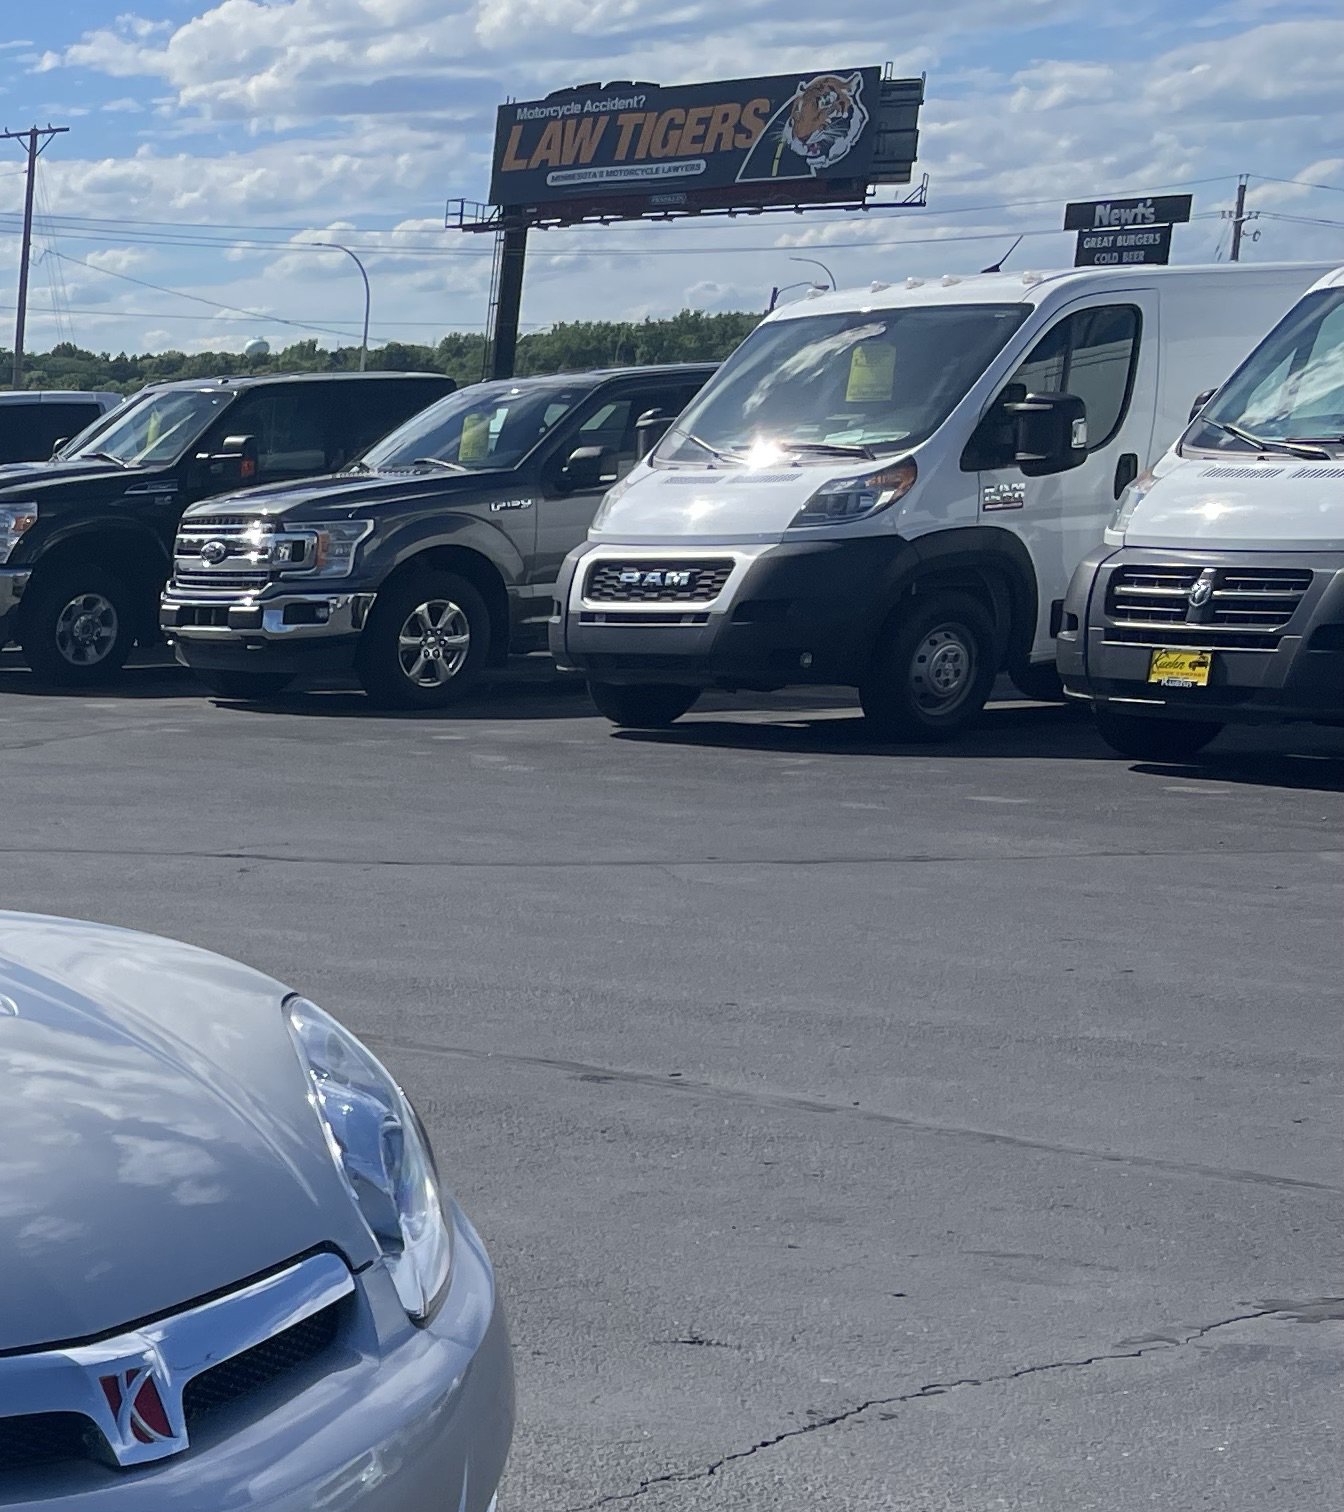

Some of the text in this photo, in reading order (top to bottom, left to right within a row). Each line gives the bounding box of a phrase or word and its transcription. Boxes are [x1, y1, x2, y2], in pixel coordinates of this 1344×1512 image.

[517, 95, 646, 120] Motorcycle Accident?
[501, 98, 770, 172] LAW TIGERS
[606, 168, 659, 178] MOTORCYCLE
[662, 163, 701, 174] LAWYERS
[1094, 199, 1155, 226] Newt's
[1083, 233, 1160, 248] GREAT BURGERS
[1094, 251, 1144, 264] COLD BEER
[620, 571, 690, 586] RAM
[1153, 652, 1186, 672] Kuehn
